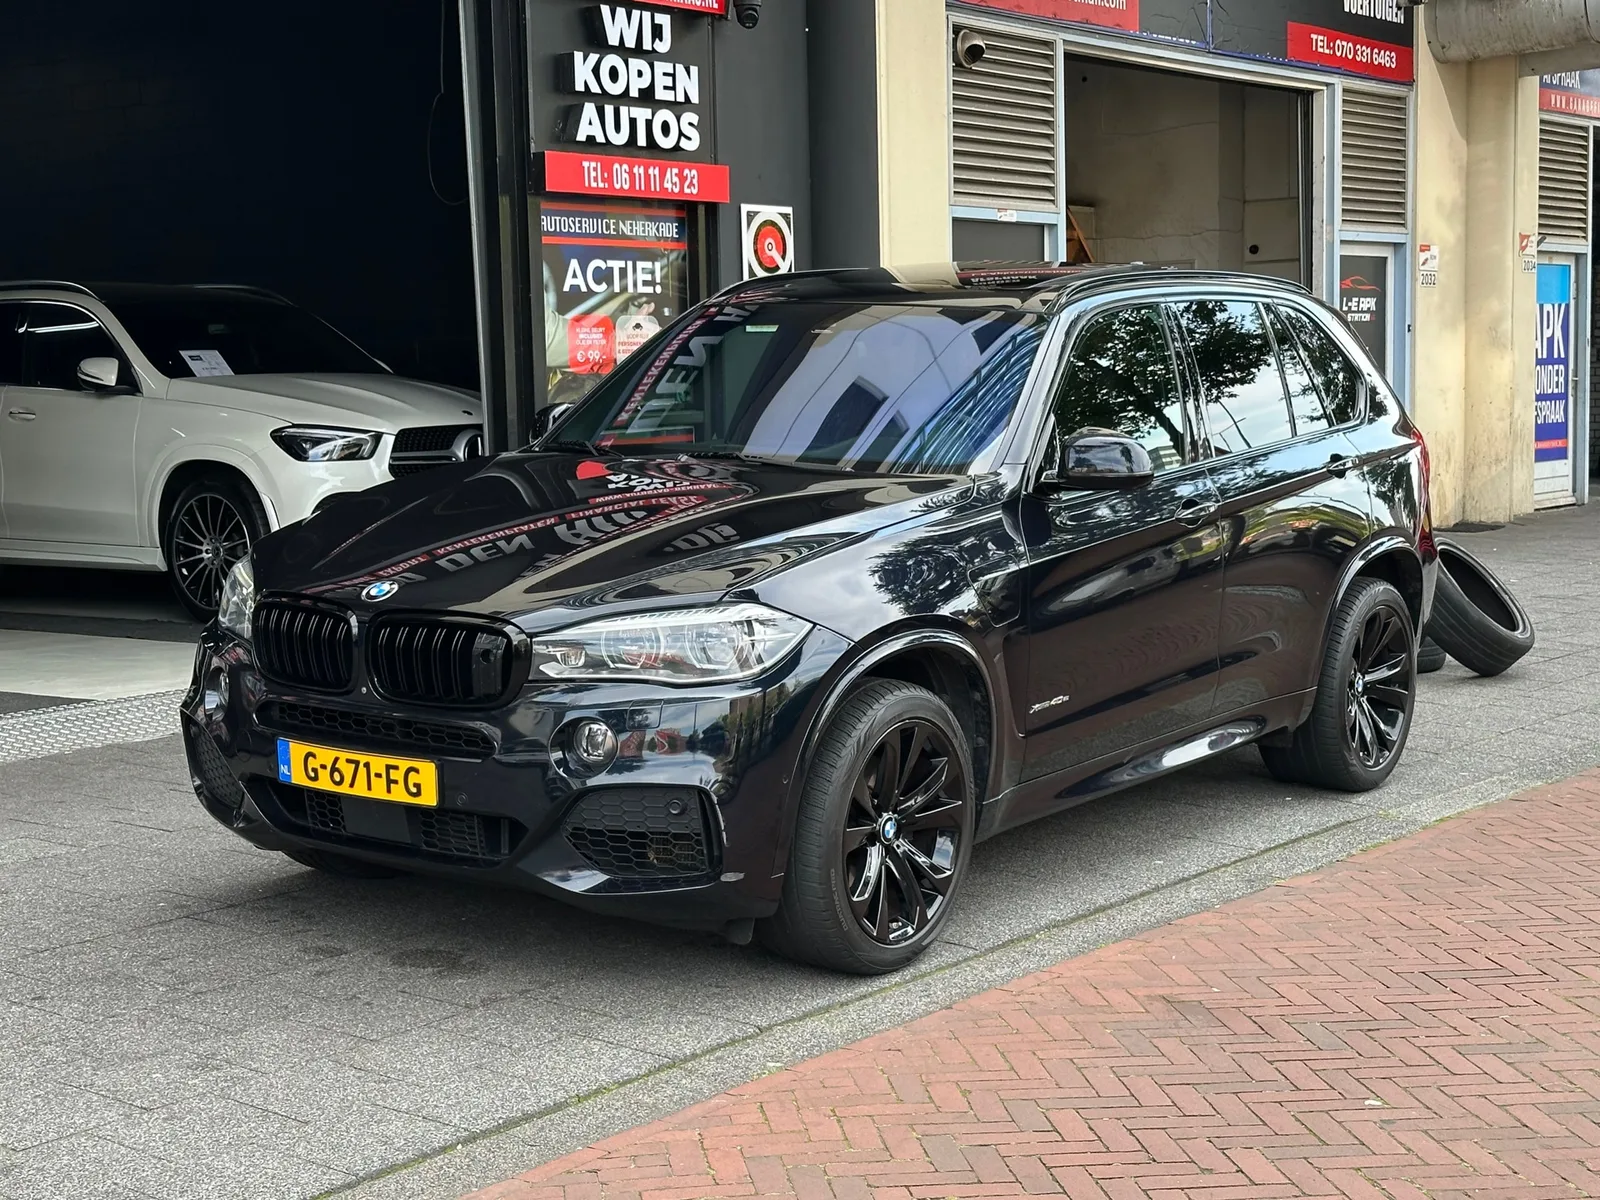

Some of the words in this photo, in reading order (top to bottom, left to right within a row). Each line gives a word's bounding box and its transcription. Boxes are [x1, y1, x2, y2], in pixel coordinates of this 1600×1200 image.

[601, 4, 671, 54] WIJ
[1310, 34, 1334, 55] TEL:
[1335, 39, 1354, 60] 070
[1355, 44, 1371, 63] 331
[1373, 48, 1397, 69] 6463
[573, 51, 699, 104] KOPEN
[576, 102, 700, 152] AUTOS
[582, 161, 608, 189] TEL:
[613, 163, 630, 190] 06
[633, 165, 645, 191] 11
[648, 166, 660, 192] 11
[664, 167, 680, 194] 45
[683, 168, 699, 195] 23
[541, 215, 617, 235] AUTOSERVICE
[619, 220, 679, 238] NEHERKADE
[563, 258, 662, 295] ACTIE!
[1421, 273, 1436, 286] 2032
[1523, 260, 1536, 271] 2034
[1359, 297, 1377, 311] APK
[1535, 303, 1565, 359] APK
[577, 351, 586, 362] €
[1535, 364, 1565, 394] ONDER
[1535, 399, 1565, 425] FSPRAAK
[281, 765, 291, 776] NL
[303, 751, 422, 798] G-671-FG
